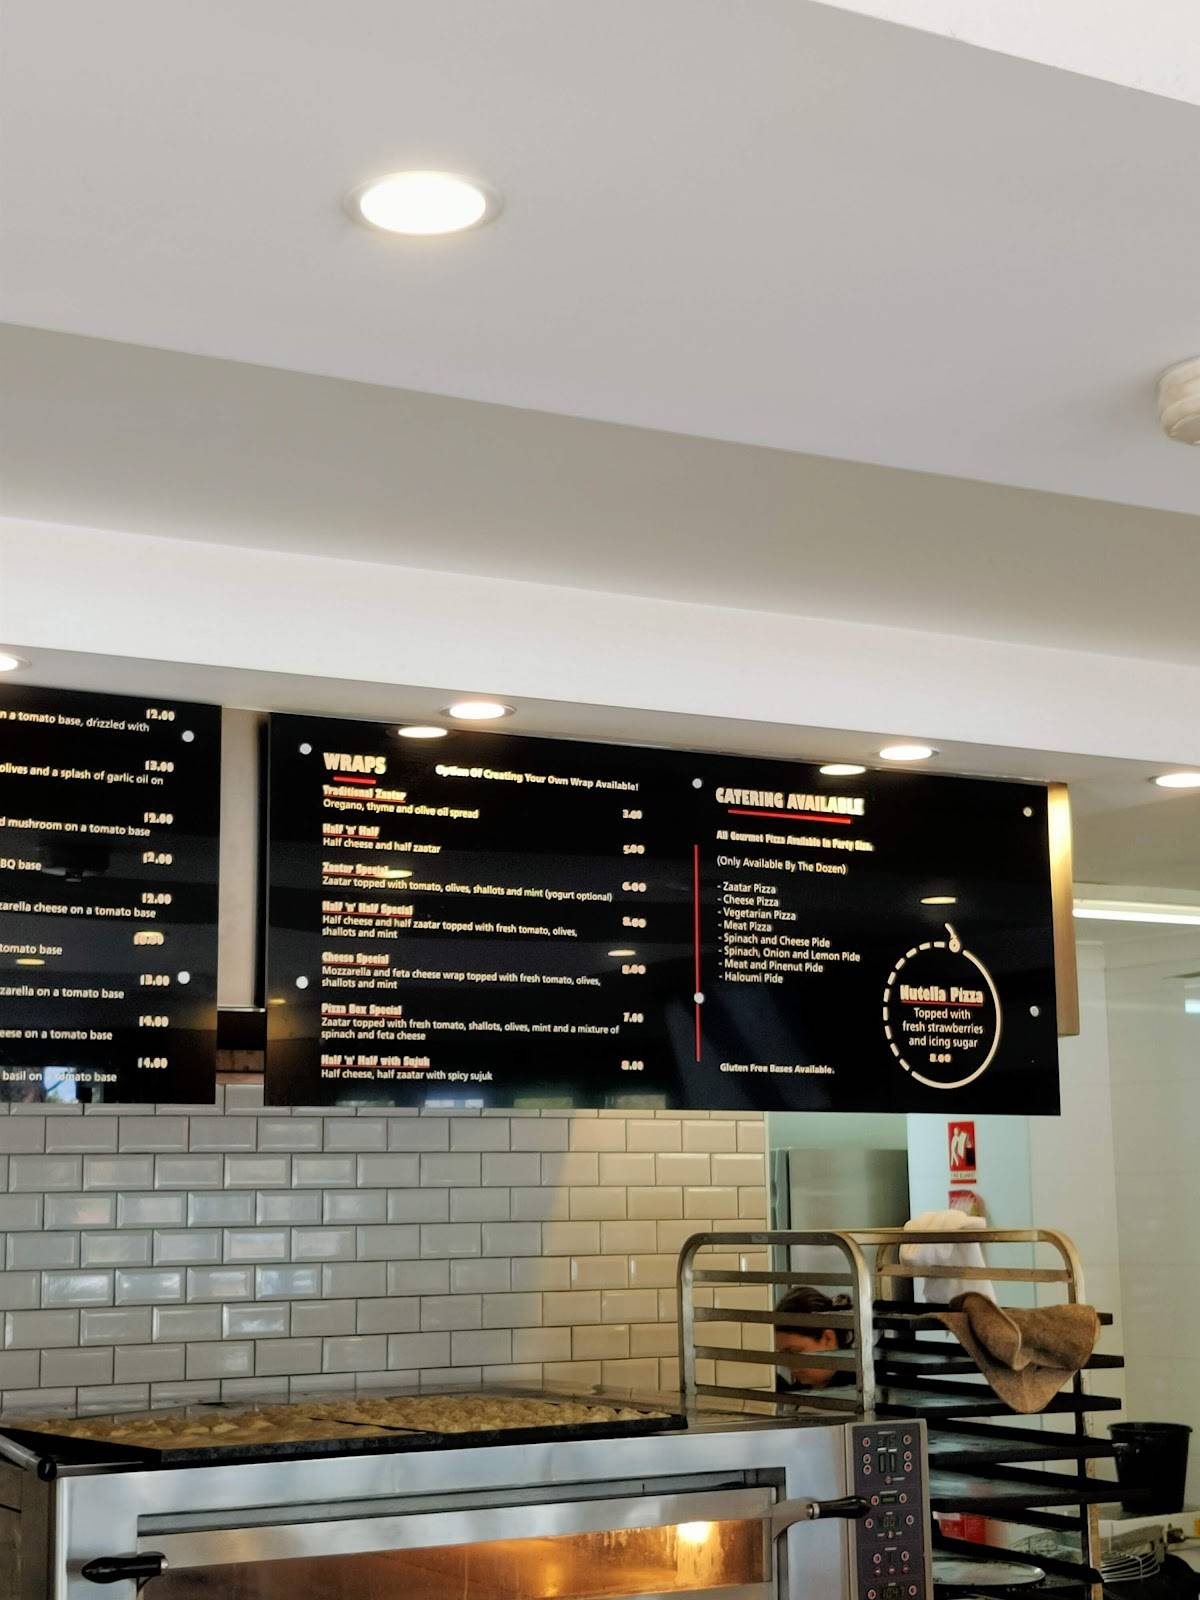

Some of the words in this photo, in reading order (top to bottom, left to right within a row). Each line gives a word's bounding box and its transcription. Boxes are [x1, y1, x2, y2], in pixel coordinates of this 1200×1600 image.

[17, 711, 56, 724] tomato
[86, 717, 125, 730] drizzled
[127, 722, 150, 732] with
[322, 751, 387, 775] WRAPS
[29, 766, 50, 776] and
[60, 768, 91, 780] splash
[106, 772, 134, 783] garlic
[136, 774, 149, 784] oil
[483, 769, 524, 783] Creating
[524, 773, 547, 783] Your
[547, 775, 569, 785] Own
[570, 777, 594, 789] Wrap
[715, 787, 784, 808] CATERING
[786, 793, 864, 816] AVAILABLE
[366, 802, 395, 814] thyme
[396, 804, 414, 814] and
[414, 805, 437, 816] olive
[436, 806, 449, 817] oil
[449, 809, 479, 819] spread
[7, 818, 63, 830] mushroom
[88, 824, 126, 835] tomato
[128, 825, 151, 837] base
[323, 837, 343, 847] Half
[343, 838, 374, 848] cheese
[375, 841, 393, 850] and
[393, 841, 412, 851] half
[412, 844, 441, 854] zaatar
[18, 859, 42, 871] base
[742, 857, 783, 870] Available
[797, 861, 814, 872] The
[322, 875, 352, 886] Zaatar
[353, 876, 387, 889] topped
[386, 877, 408, 889] with
[473, 884, 505, 895] shallots
[506, 887, 523, 896] and
[524, 888, 544, 897] mint
[723, 881, 752, 892] Zaatar
[753, 883, 777, 894] Pizza
[723, 894, 755, 906] Cheese
[756, 896, 779, 907] Pizza
[33, 902, 68, 914] cheese
[94, 906, 132, 917] tomato
[133, 907, 156, 918] base
[723, 907, 772, 920] Vegetarian
[773, 910, 797, 921] Pizza
[322, 914, 342, 924] Half
[342, 915, 374, 926] cheese
[374, 917, 393, 927] and
[393, 918, 412, 928] half
[413, 920, 441, 929] zaatar
[442, 921, 473, 932] topped
[474, 922, 494, 932] with
[496, 923, 517, 933] fresh
[723, 919, 747, 931] Meat
[749, 921, 772, 932] Pizza
[322, 926, 356, 937] shallots
[358, 928, 375, 938] and
[377, 929, 398, 939] mint
[723, 932, 758, 945] Spinach
[760, 935, 778, 945] and
[779, 935, 810, 947] Cheese
[811, 937, 830, 948] Pide
[39, 944, 63, 955] base
[763, 947, 790, 958] Onion
[792, 949, 809, 959] and
[811, 950, 840, 961] Lemon
[842, 951, 861, 962] Pide
[724, 958, 748, 969] Meat
[750, 959, 767, 970] and
[769, 960, 803, 972] Pinenut
[804, 962, 824, 973] Pide
[322, 965, 372, 976] Mozzarella
[372, 968, 391, 978] and
[392, 967, 411, 978] feta
[412, 969, 441, 979] cheese
[442, 972, 465, 981] wrap
[466, 972, 498, 983] topped
[498, 972, 518, 982] with
[519, 973, 541, 983] fresh
[724, 971, 762, 982] Haloumi
[764, 973, 784, 984] Pide
[321, 977, 356, 988] shallots
[357, 978, 375, 988] and
[377, 979, 398, 989] mint
[62, 988, 99, 998] tomato
[101, 988, 125, 999] base
[900, 984, 946, 1002] Nutella
[950, 986, 984, 1003] Pizza
[913, 1007, 948, 1020] Topped
[949, 1008, 971, 1020] with
[321, 1017, 352, 1028] Zaatar
[352, 1017, 386, 1029] topped
[386, 1018, 408, 1029] with
[409, 1018, 431, 1029] fresh
[531, 1023, 551, 1032] mint
[553, 1023, 569, 1033] and
[577, 1024, 609, 1034] mixture
[902, 1020, 926, 1032] fresh
[927, 1022, 983, 1034] strawberries
[50, 1029, 88, 1040] tomato
[90, 1029, 113, 1040] base
[321, 1029, 356, 1040] spinach
[357, 1030, 375, 1039] and
[376, 1029, 395, 1040] feta
[396, 1030, 426, 1040] cheese
[908, 1035, 927, 1046] and
[928, 1035, 951, 1049] icing
[952, 1038, 978, 1050] sugar
[321, 1068, 341, 1078] Half
[377, 1069, 395, 1079] half
[396, 1071, 425, 1079] zaatar
[426, 1070, 446, 1079] with
[447, 1071, 469, 1082] spicy
[470, 1071, 493, 1082] sujuk
[720, 1062, 749, 1072] Gluten
[750, 1063, 768, 1072] Free
[769, 1064, 793, 1073] Bases
[794, 1064, 835, 1074] Available.
[2, 1070, 26, 1081] basil
[93, 1071, 118, 1082] base
